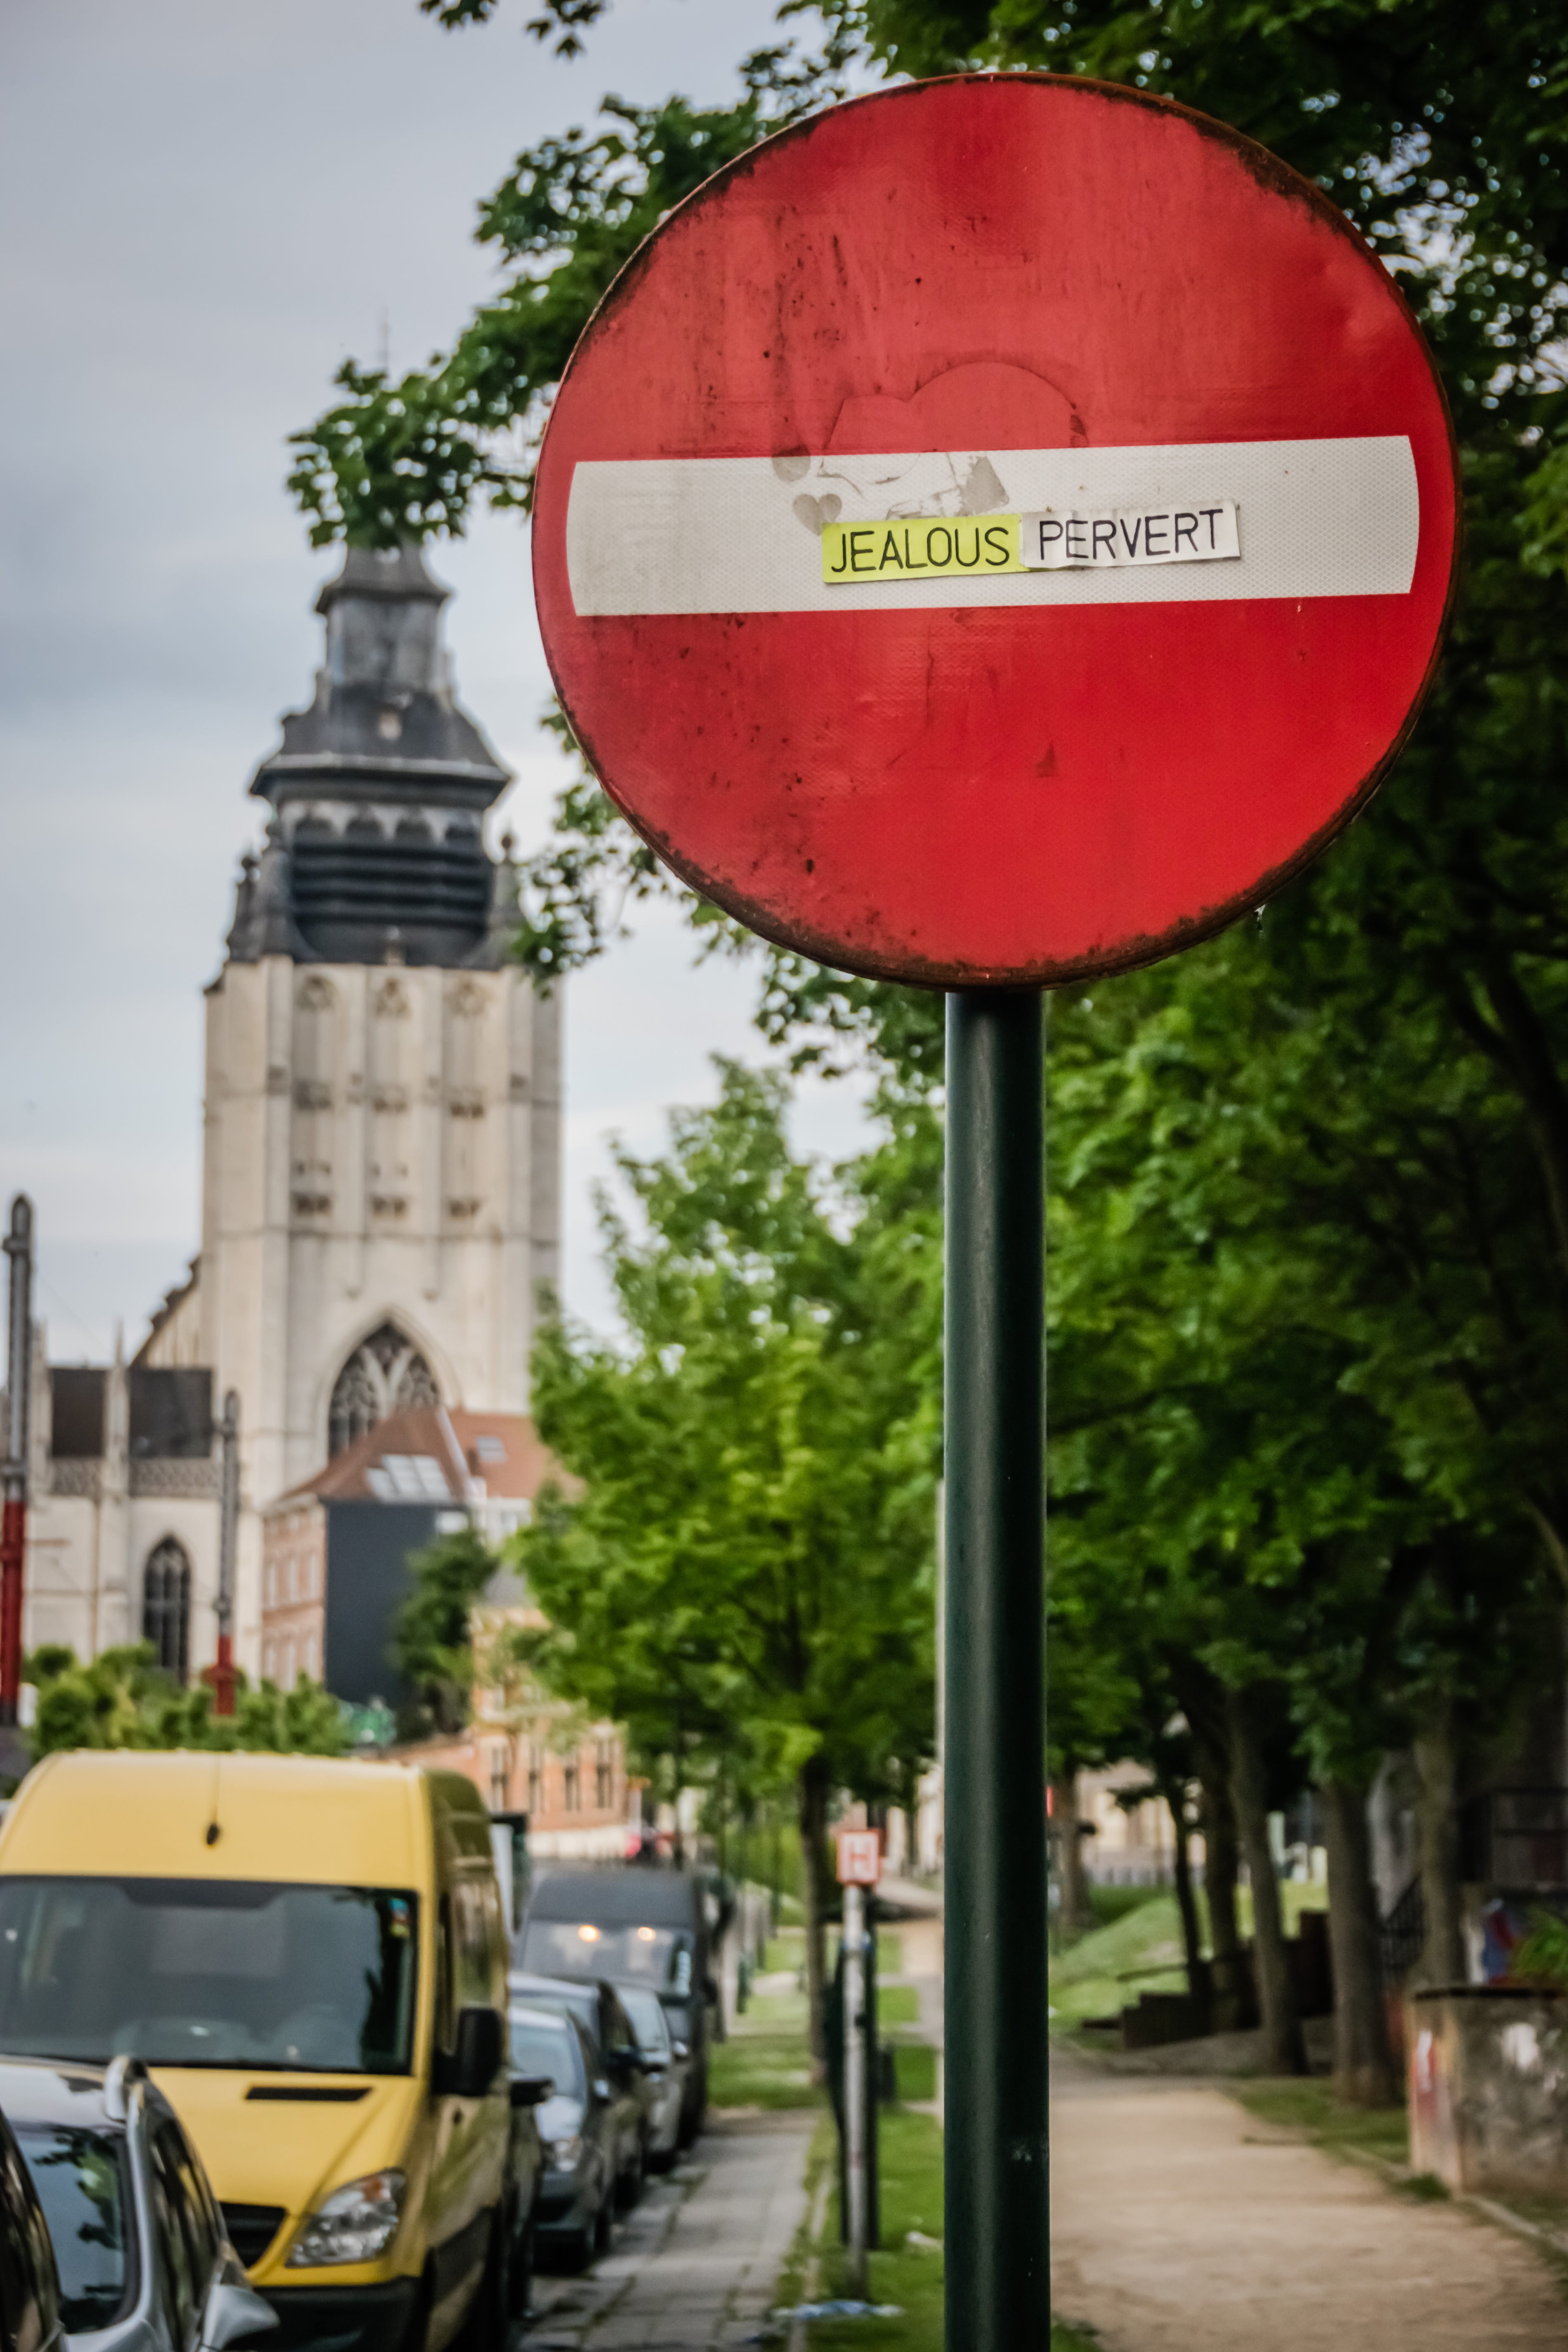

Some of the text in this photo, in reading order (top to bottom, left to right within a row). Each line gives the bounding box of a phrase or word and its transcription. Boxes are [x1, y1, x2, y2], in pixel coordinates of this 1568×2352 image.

[831, 508, 1224, 573] JEALOUS PERVERT
[848, 1841, 871, 1874] H
